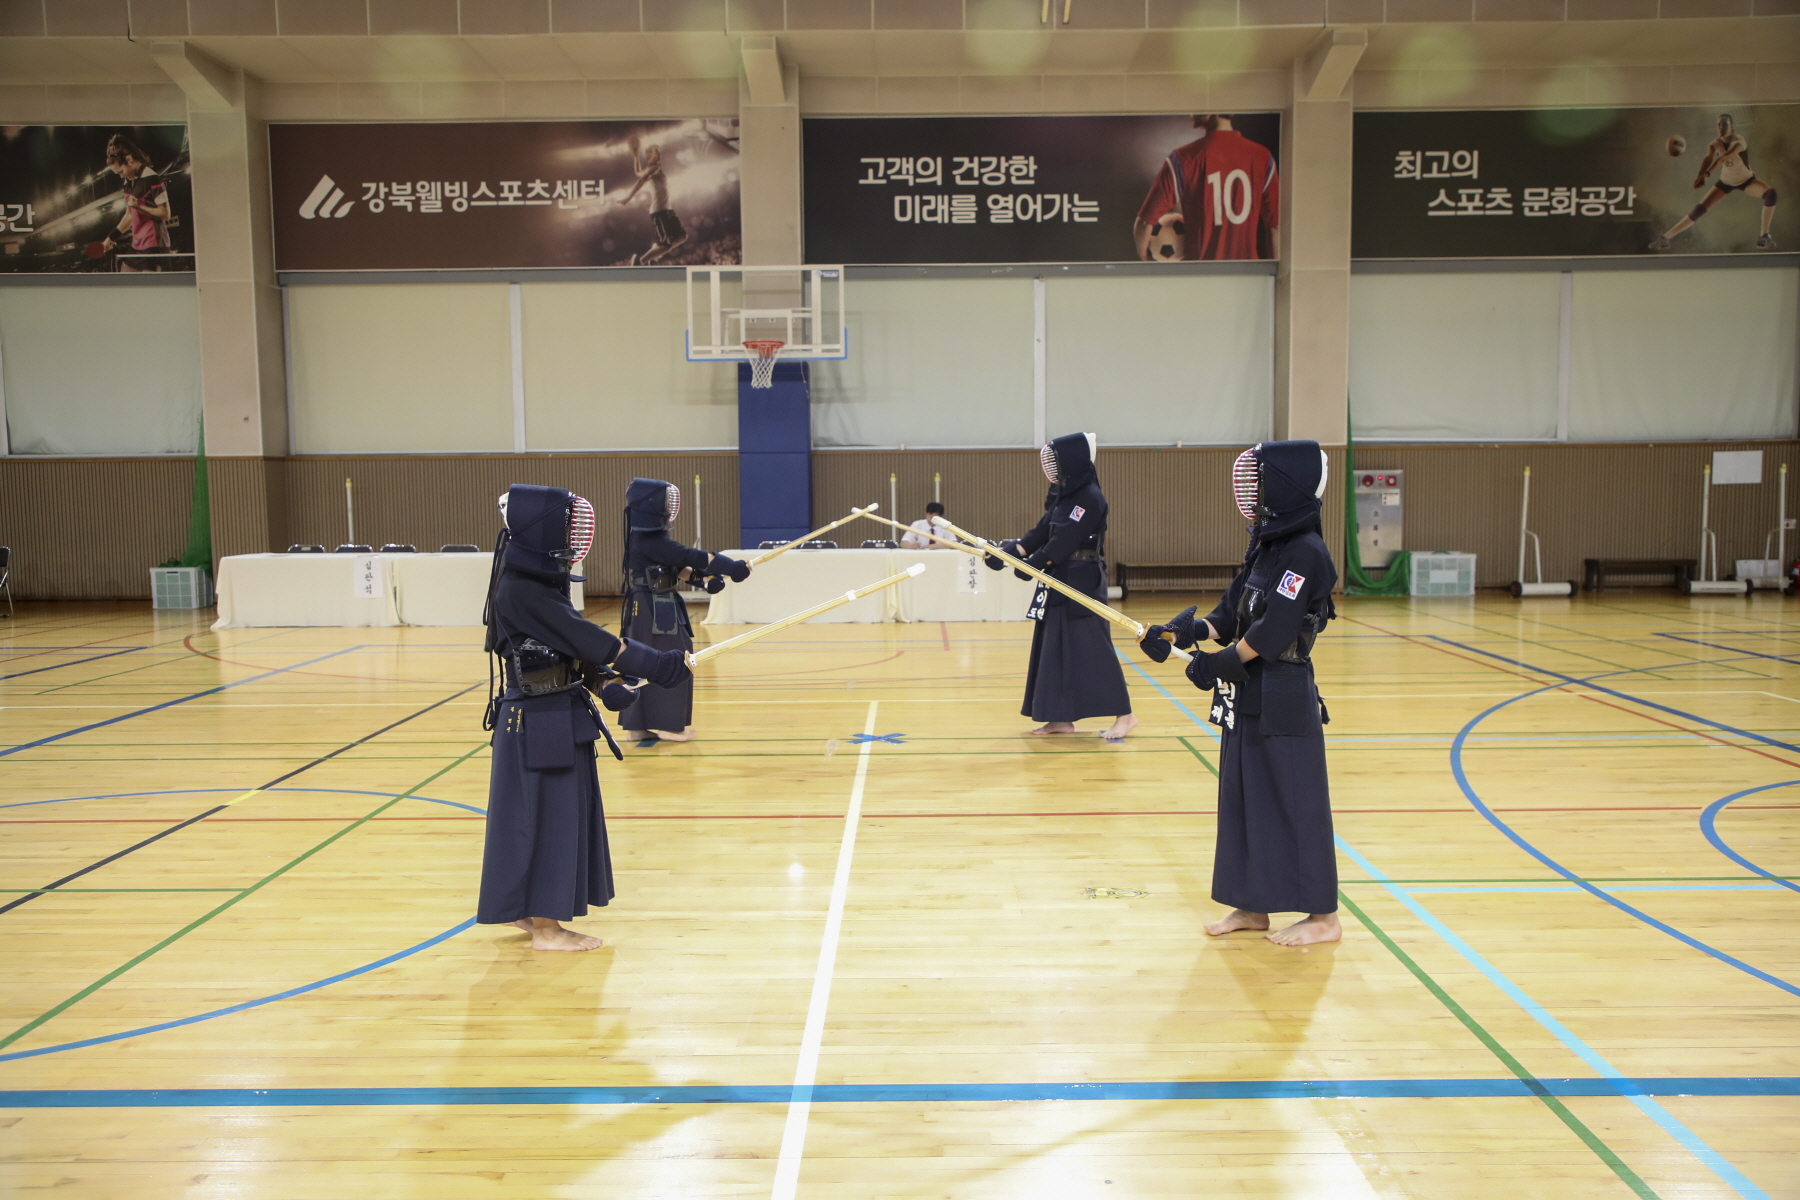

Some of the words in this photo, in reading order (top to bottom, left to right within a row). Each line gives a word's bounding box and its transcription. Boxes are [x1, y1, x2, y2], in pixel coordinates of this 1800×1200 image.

[858, 156, 942, 187] 고객의
[952, 155, 1038, 186] 건강한
[1394, 150, 1479, 180] 최고의
[361, 179, 606, 213] 강북웰빙스포츠센터
[894, 194, 978, 224] 미래를
[987, 193, 1100, 223] 열어가는
[1207, 168, 1252, 226] 10
[1427, 188, 1513, 216] 스포츠
[1521, 186, 1637, 217] 문화공간
[0, 203, 36, 233] 간
